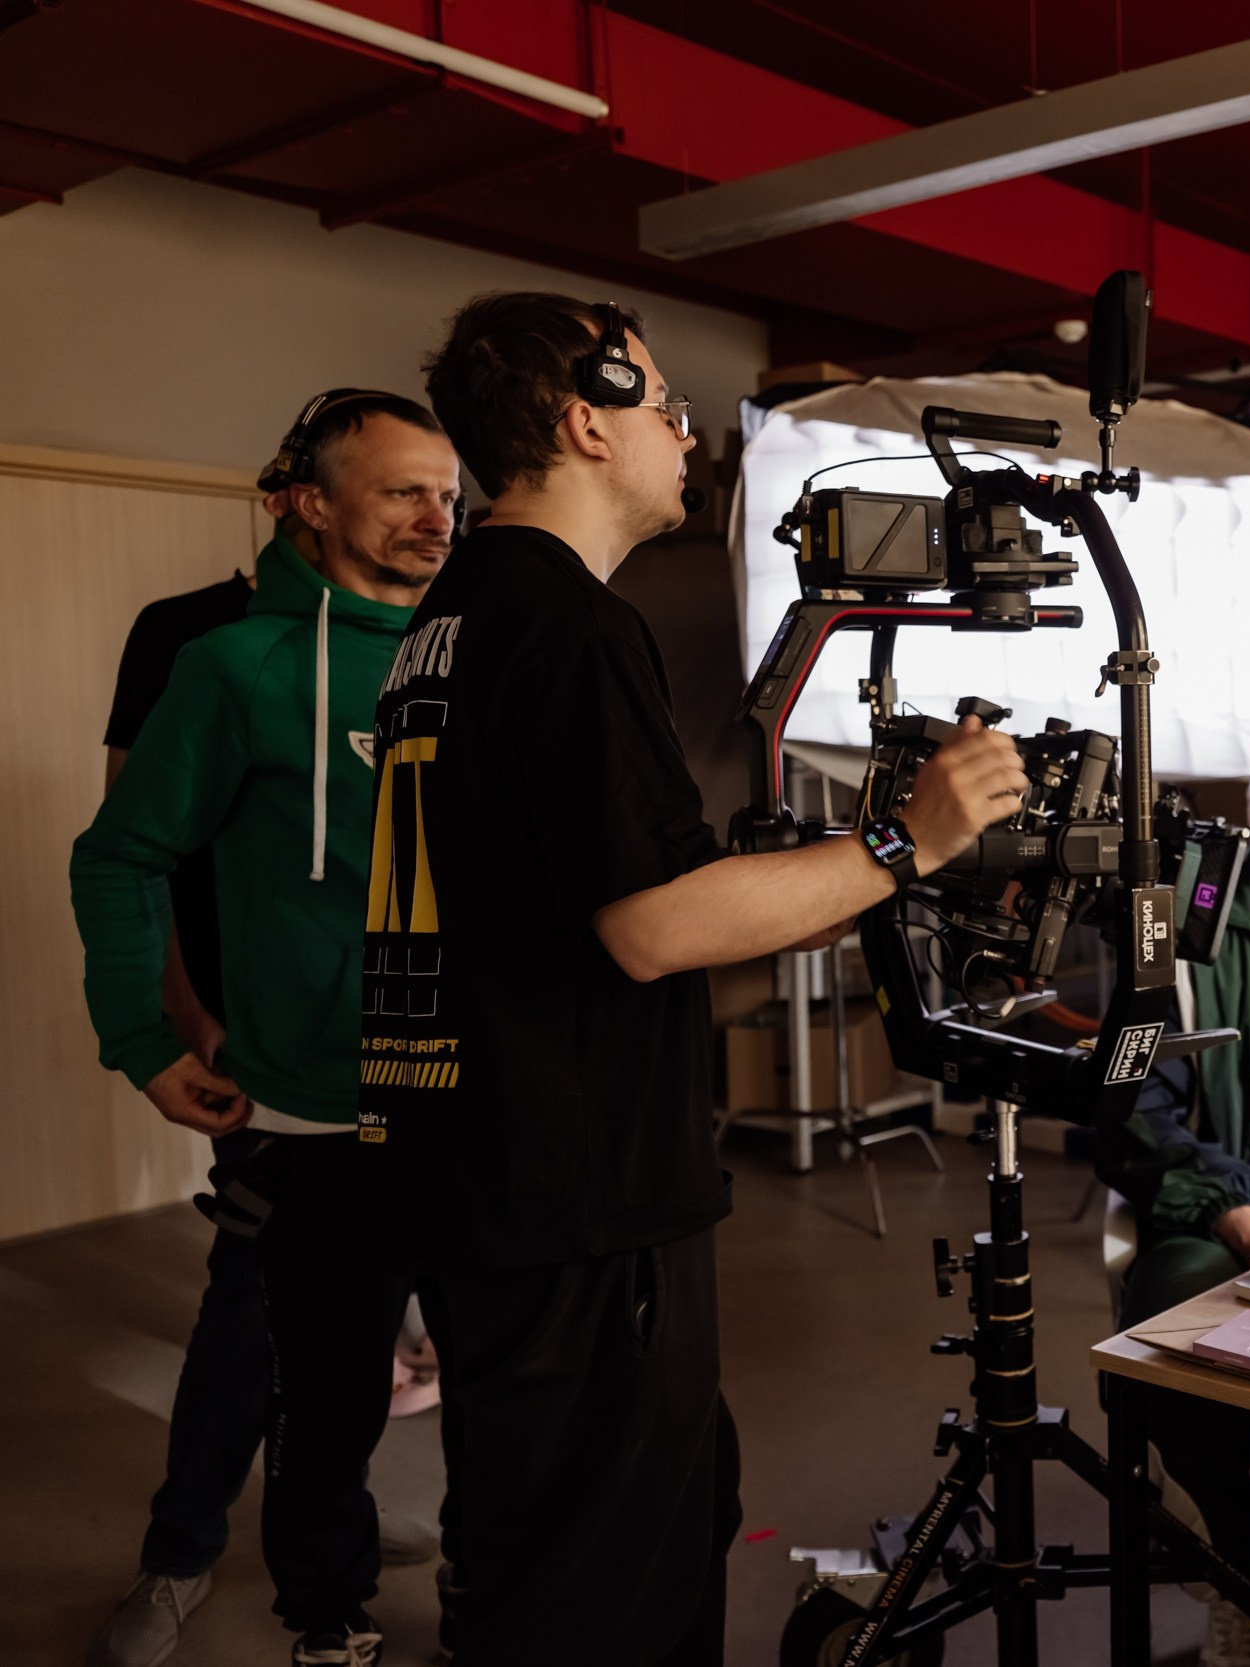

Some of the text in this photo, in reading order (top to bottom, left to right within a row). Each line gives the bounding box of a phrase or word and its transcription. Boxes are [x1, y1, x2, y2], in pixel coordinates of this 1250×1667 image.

[612, 348, 623, 359] 6
[1142, 900, 1154, 963] КИНОЦЕХ
[409, 1039, 459, 1054] DRIFT
[1118, 1029, 1143, 1079] СКРИН
[1141, 1028, 1157, 1056] БИГ
[363, 1130, 383, 1140] DRIFT
[878, 1491, 953, 1609] MYRENTAL CINEMA
